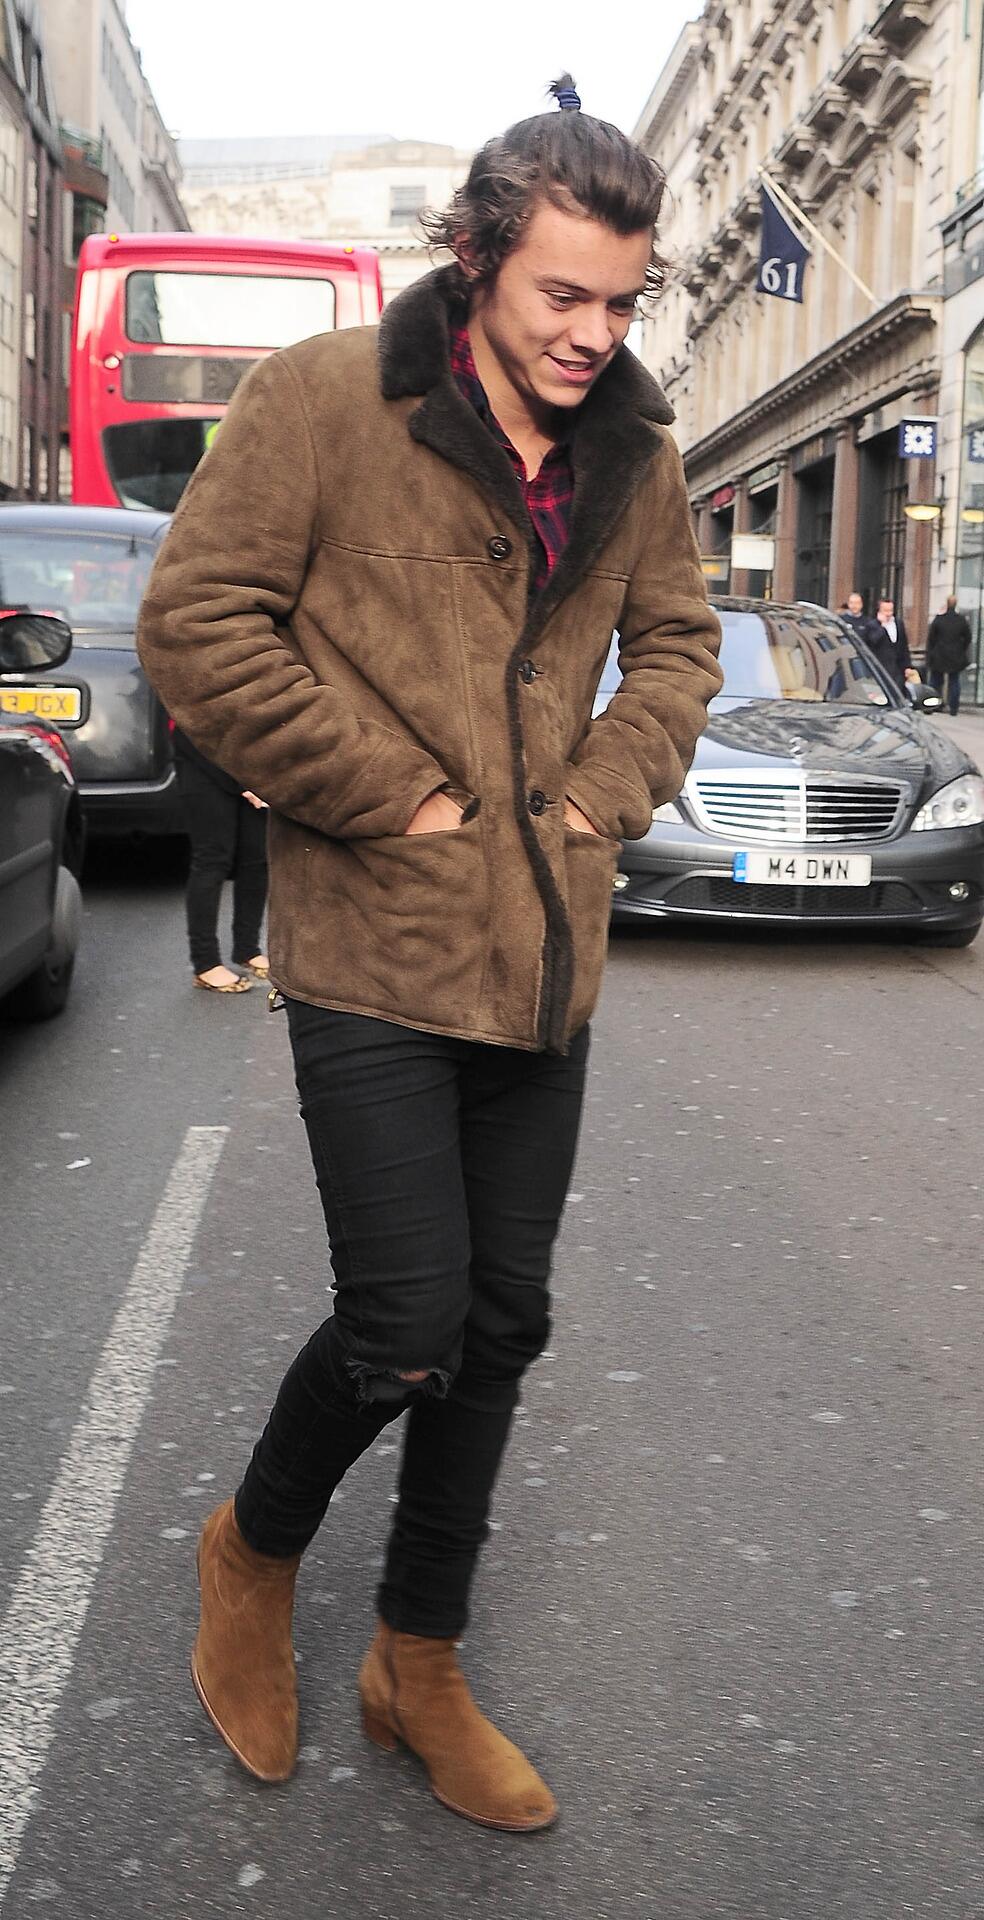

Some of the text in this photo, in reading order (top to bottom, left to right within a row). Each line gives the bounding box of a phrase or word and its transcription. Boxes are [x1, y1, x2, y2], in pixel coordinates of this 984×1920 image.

[761, 257, 797, 298] 61
[27, 695, 66, 713] JGX
[767, 857, 849, 880] M4 DWN
